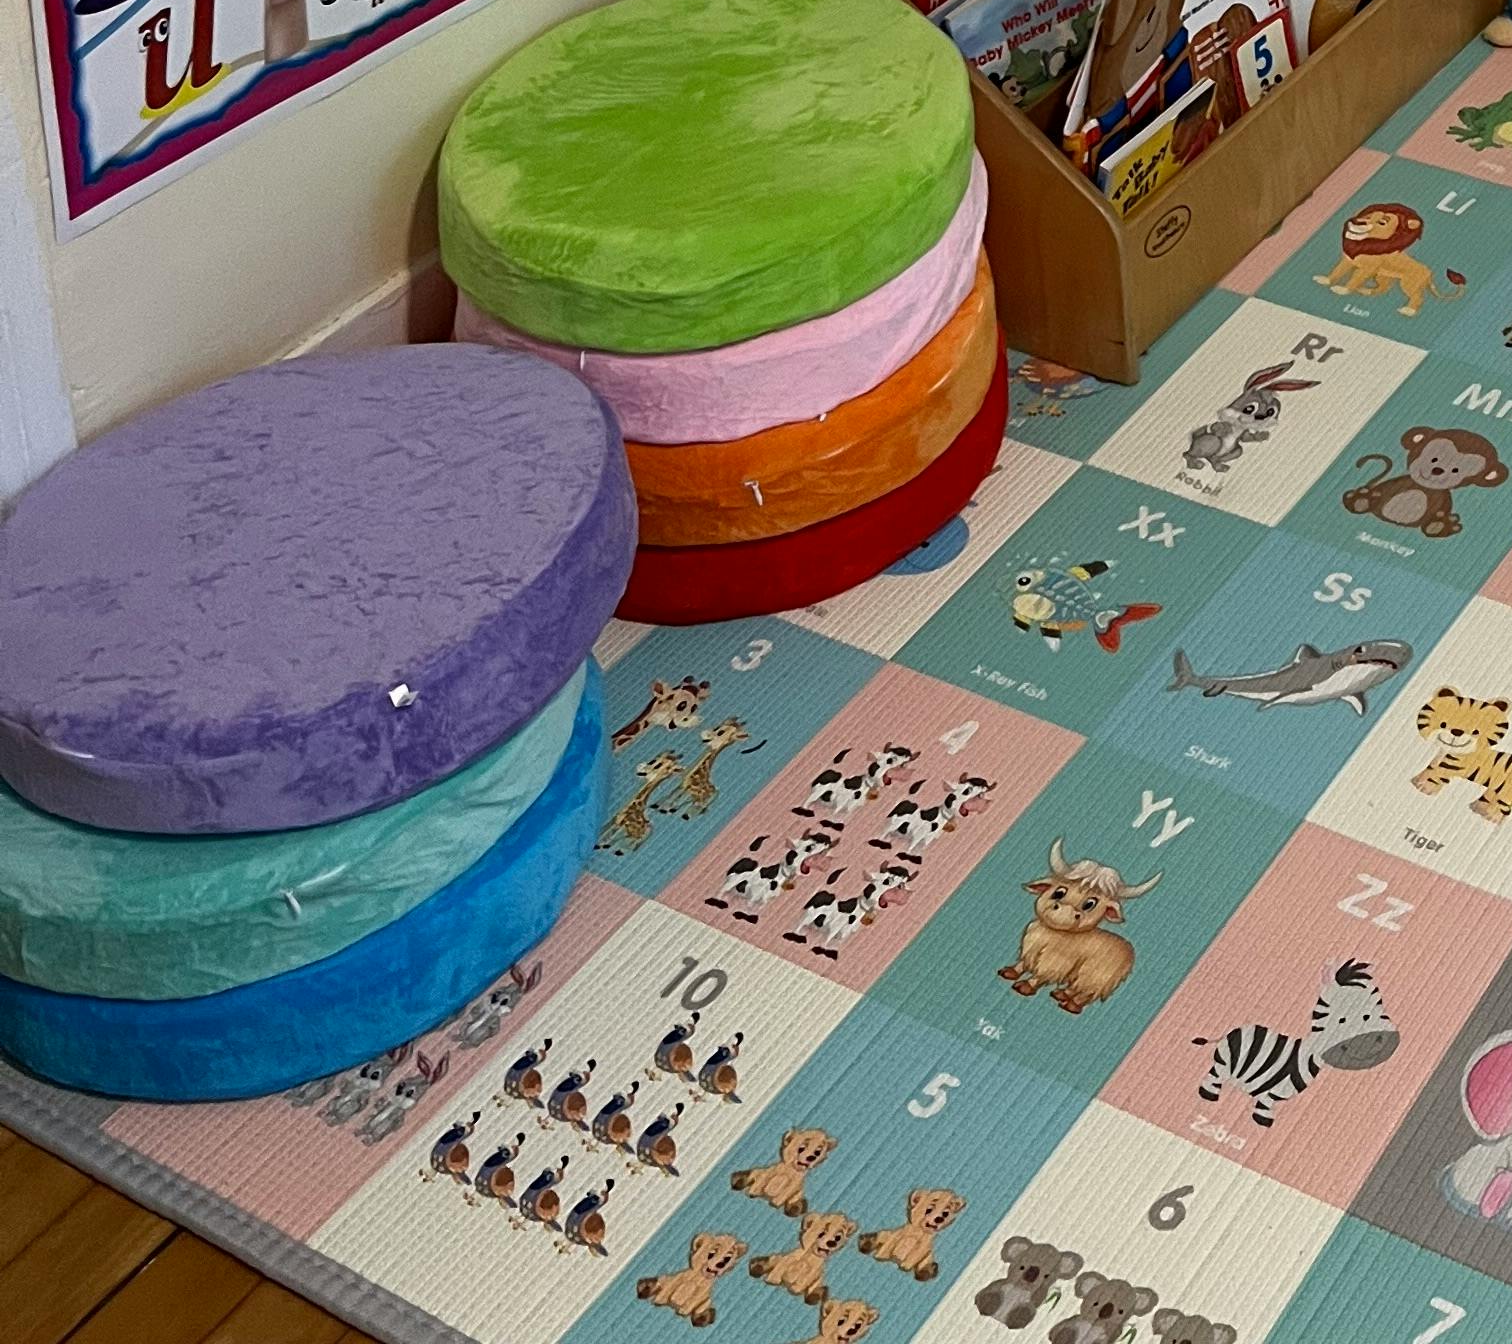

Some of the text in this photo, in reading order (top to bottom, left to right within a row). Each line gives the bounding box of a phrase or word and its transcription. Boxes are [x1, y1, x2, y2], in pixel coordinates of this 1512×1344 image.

[1001, 12, 1031, 33] Who
[1006, 19, 1053, 51] Mickey
[1254, 35, 1273, 79] 5
[1184, 743, 1233, 771] Shark
[1402, 825, 1447, 855] Tiger
[660, 955, 729, 1013] 10
[906, 1070, 962, 1119] 5
[1148, 1185, 1195, 1231] 6
